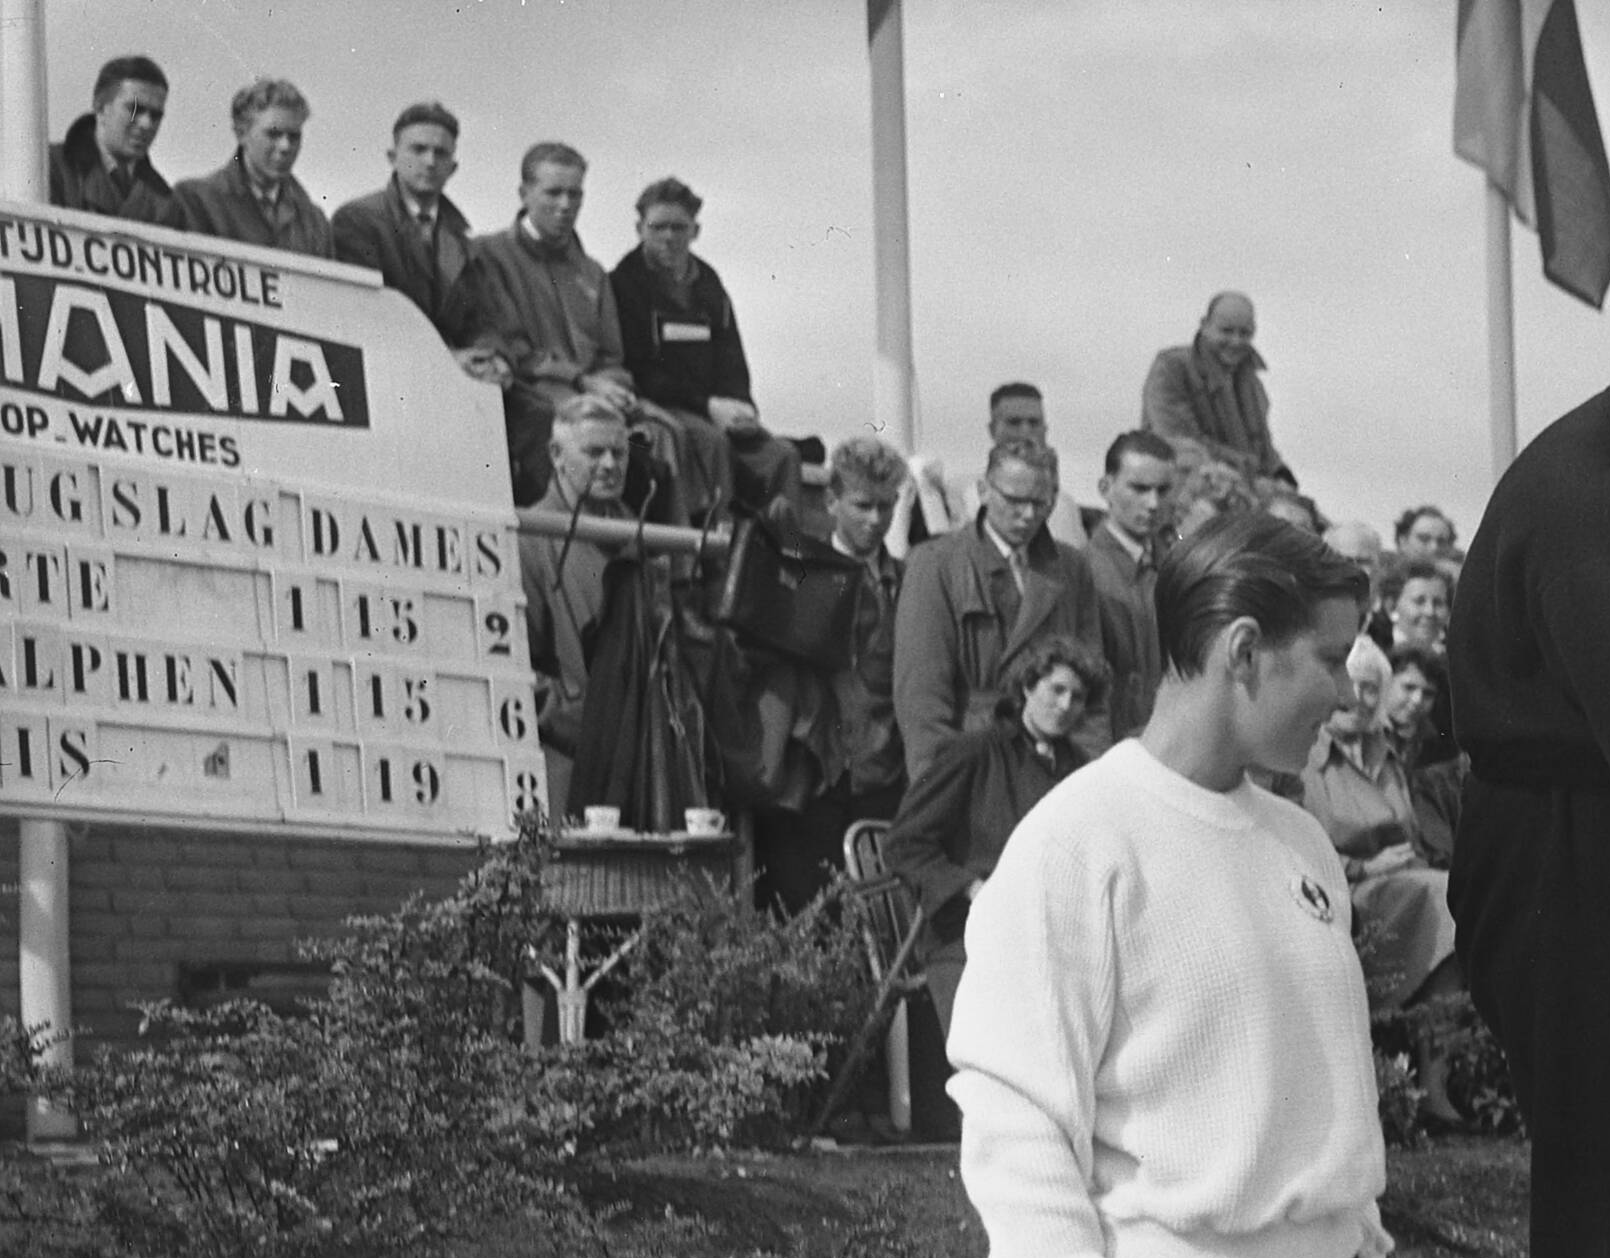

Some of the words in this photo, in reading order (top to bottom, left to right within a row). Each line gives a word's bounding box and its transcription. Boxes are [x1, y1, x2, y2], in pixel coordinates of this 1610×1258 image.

[312, 509, 501, 577] DAMES
[291, 586, 304, 632] 1
[358, 595, 418, 643] 15
[485, 611, 511, 657] 2
[0, 637, 237, 707] LPHEN
[308, 670, 321, 715] 1
[371, 674, 431, 723] 15
[500, 699, 526, 740] 6
[308, 750, 322, 794] 1
[379, 758, 439, 804] 19
[516, 772, 539, 813] 8
